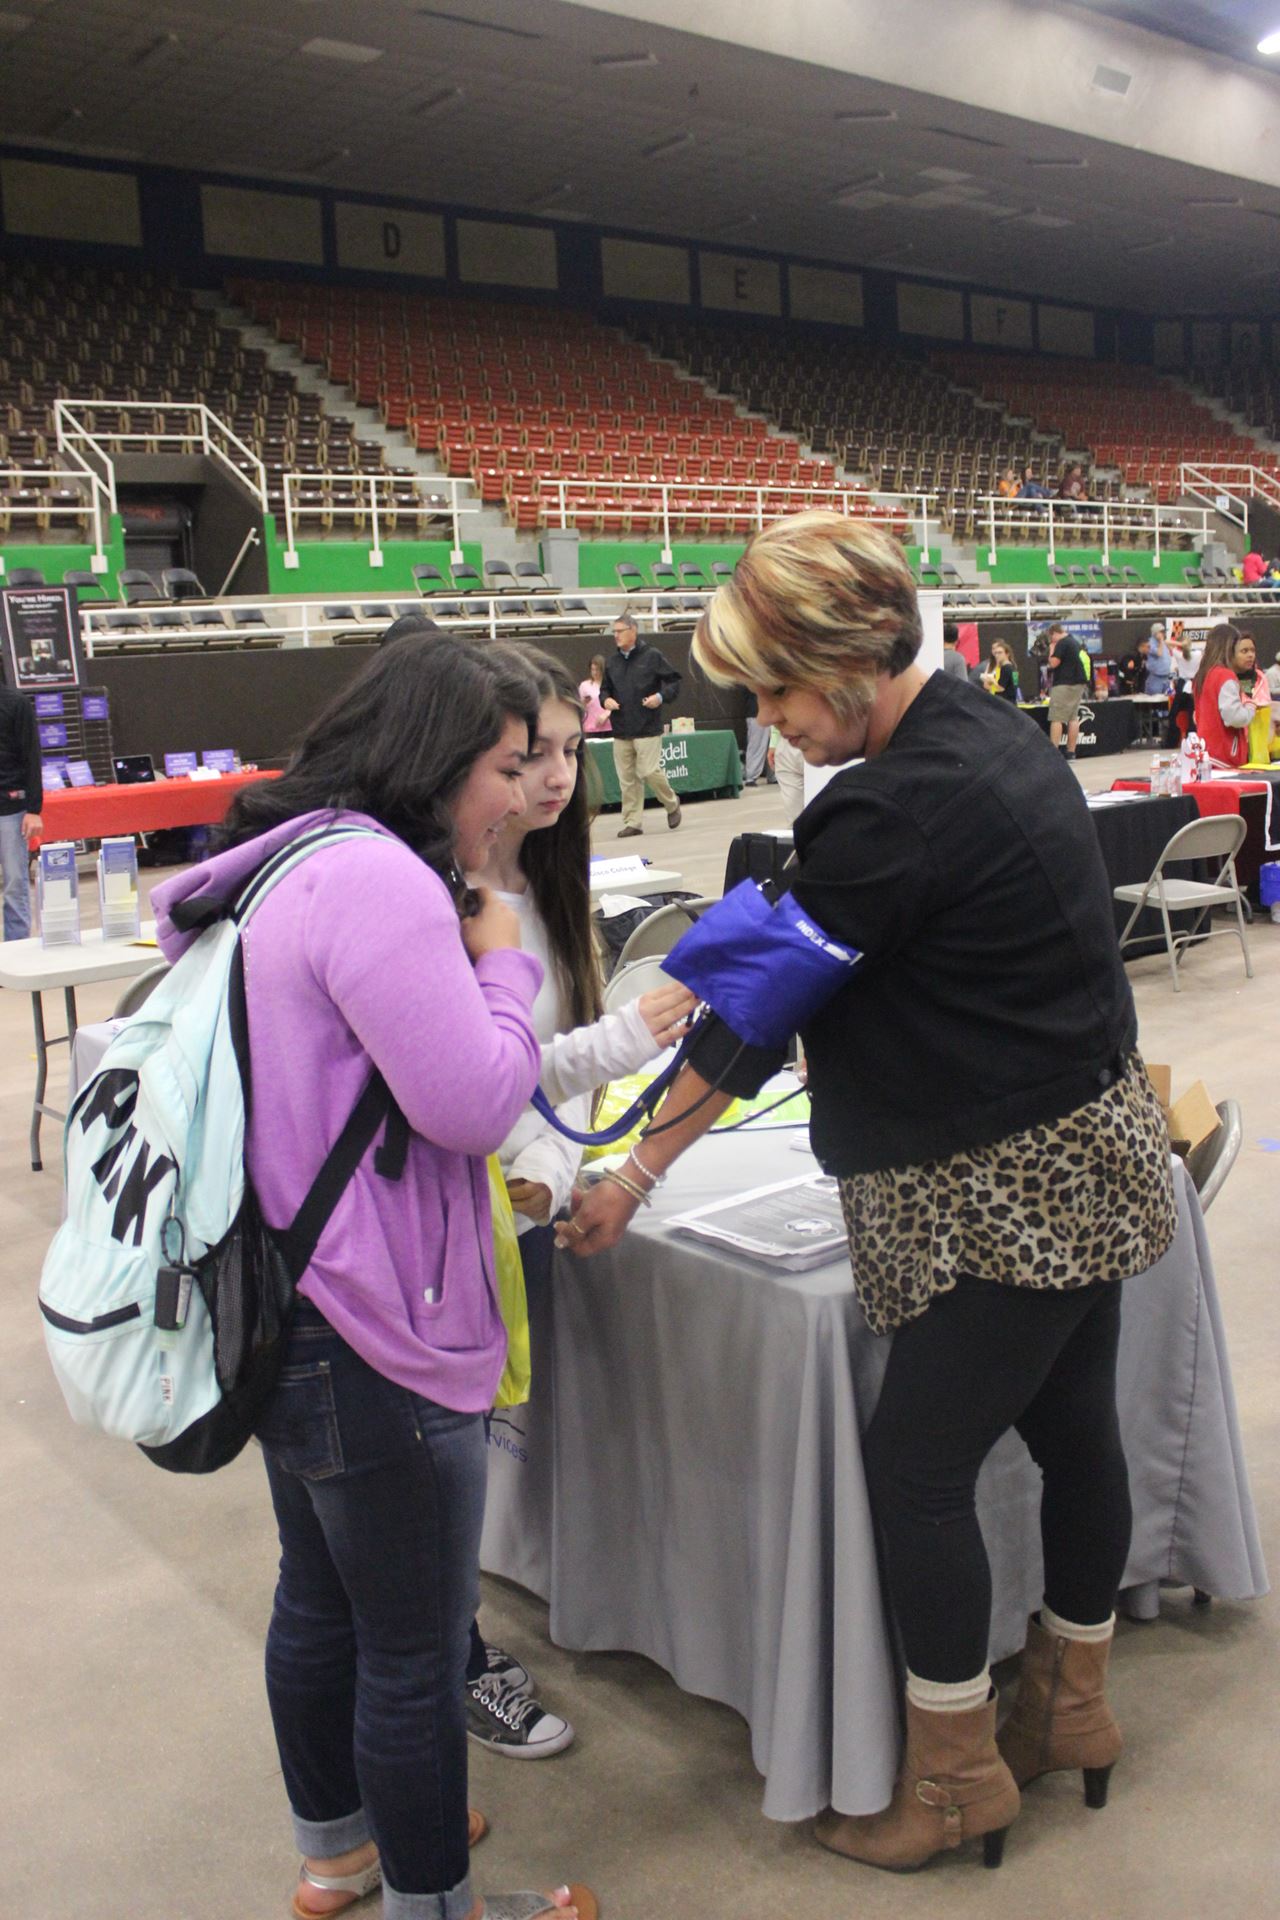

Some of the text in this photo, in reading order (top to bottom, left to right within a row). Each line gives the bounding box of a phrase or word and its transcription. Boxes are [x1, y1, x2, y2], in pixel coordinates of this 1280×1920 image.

[382, 220, 401, 260] D
[734, 267, 748, 299] E
[1182, 630, 1209, 641] WESTE
[658, 740, 688, 768] gdell
[663, 764, 689, 779] ealth
[795, 919, 827, 948] INDEX
[489, 1431, 528, 1463] rvices
